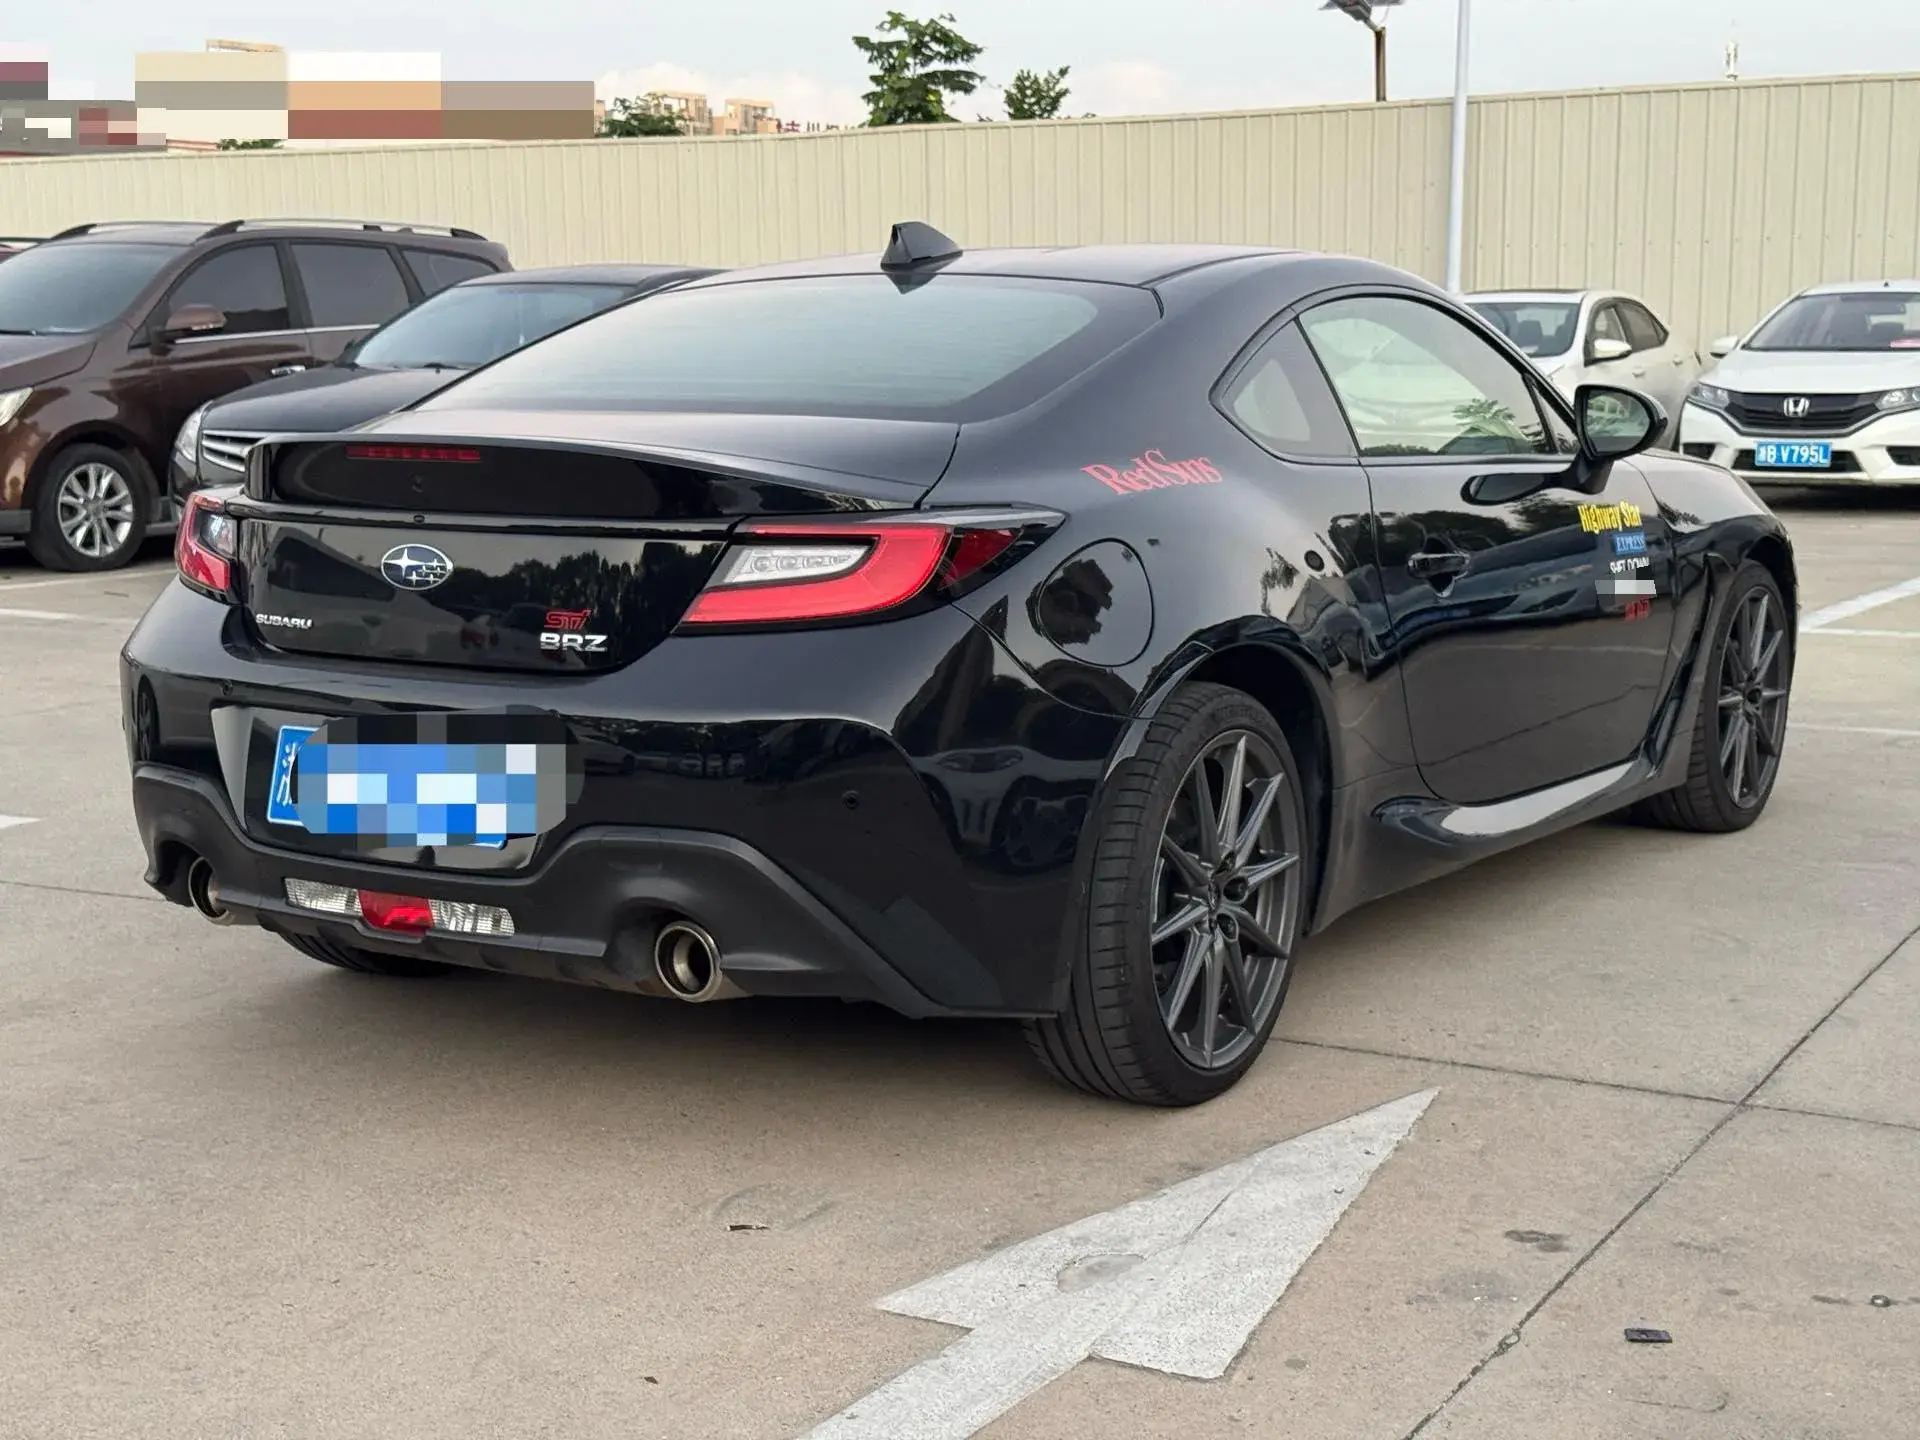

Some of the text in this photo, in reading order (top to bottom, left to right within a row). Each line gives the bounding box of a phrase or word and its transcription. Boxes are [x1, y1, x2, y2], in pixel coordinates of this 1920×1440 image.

[1578, 499, 1642, 534] Highway Star
[256, 613, 313, 629] SUBARU
[540, 632, 608, 652] BRZ
